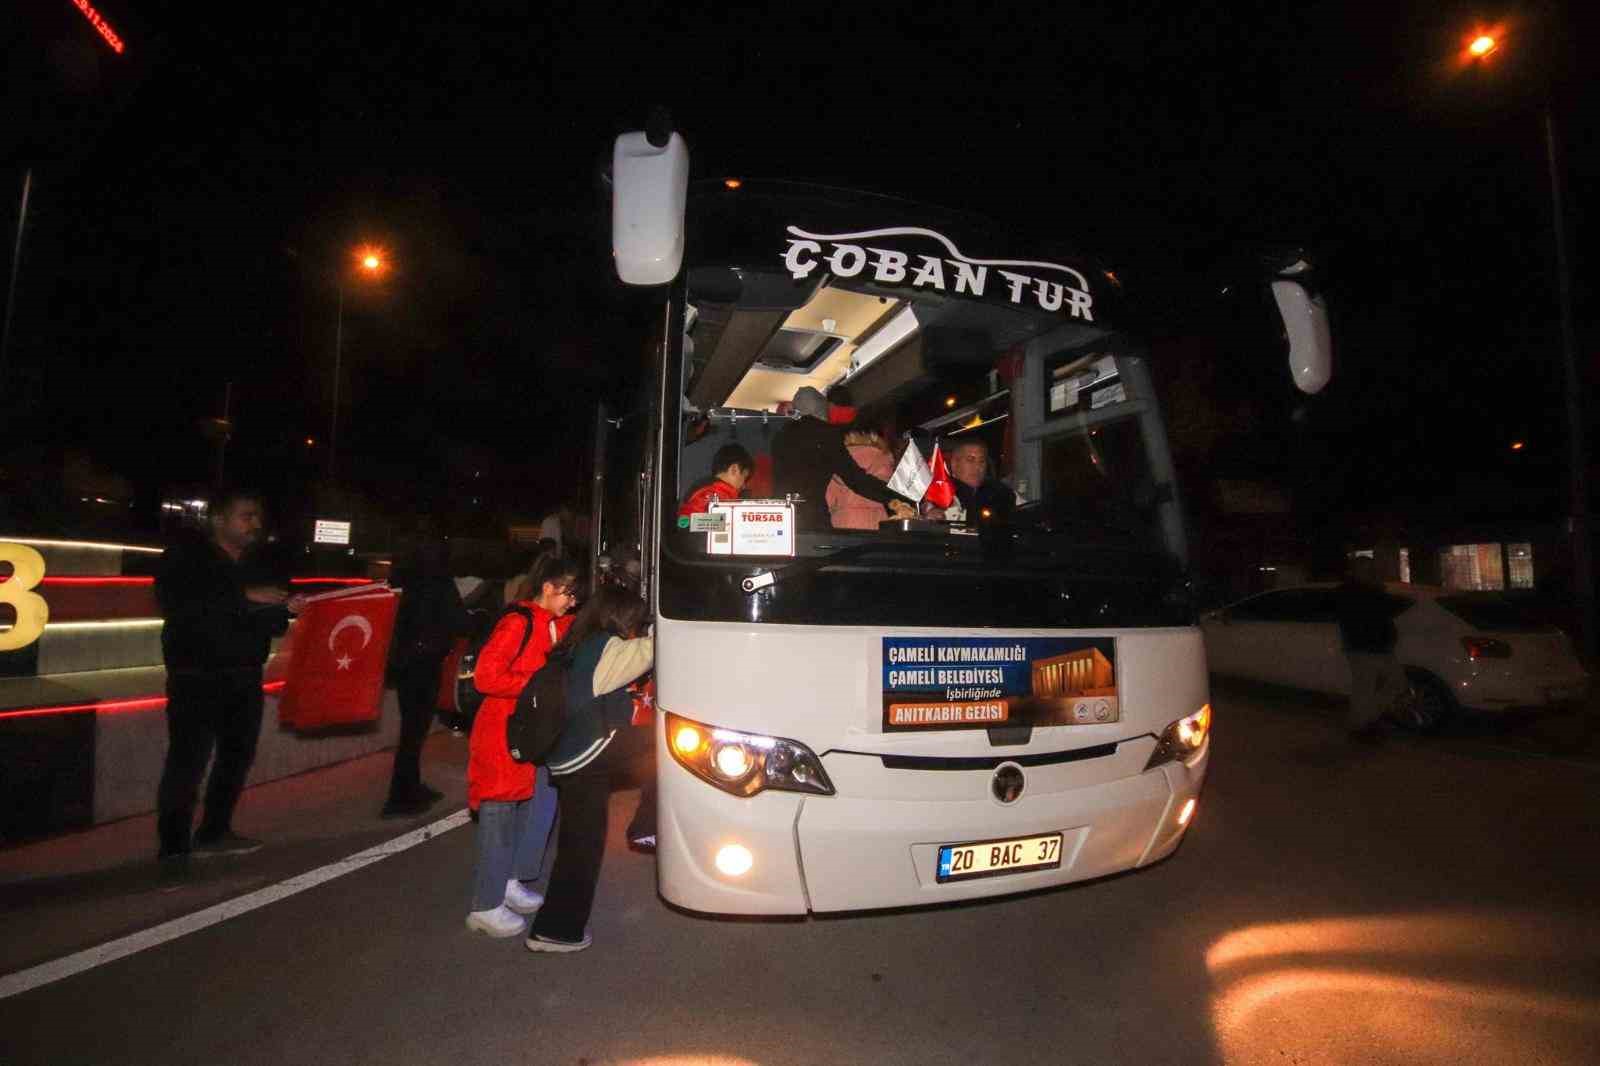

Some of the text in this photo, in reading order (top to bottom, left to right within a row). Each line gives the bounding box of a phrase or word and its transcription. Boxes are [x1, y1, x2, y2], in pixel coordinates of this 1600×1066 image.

[780, 239, 1093, 321] ÇOBAN TUR
[889, 645, 1026, 664] ÇAMELİ KAYMAKAMLIĞI
[889, 668, 1004, 688] ÇAMELİ BELEDİYESİ
[896, 702, 1003, 722] ANITKABİR GEZİSİ
[952, 850, 974, 871] 20
[990, 844, 1022, 866] BAC
[1038, 839, 1059, 860] 37
